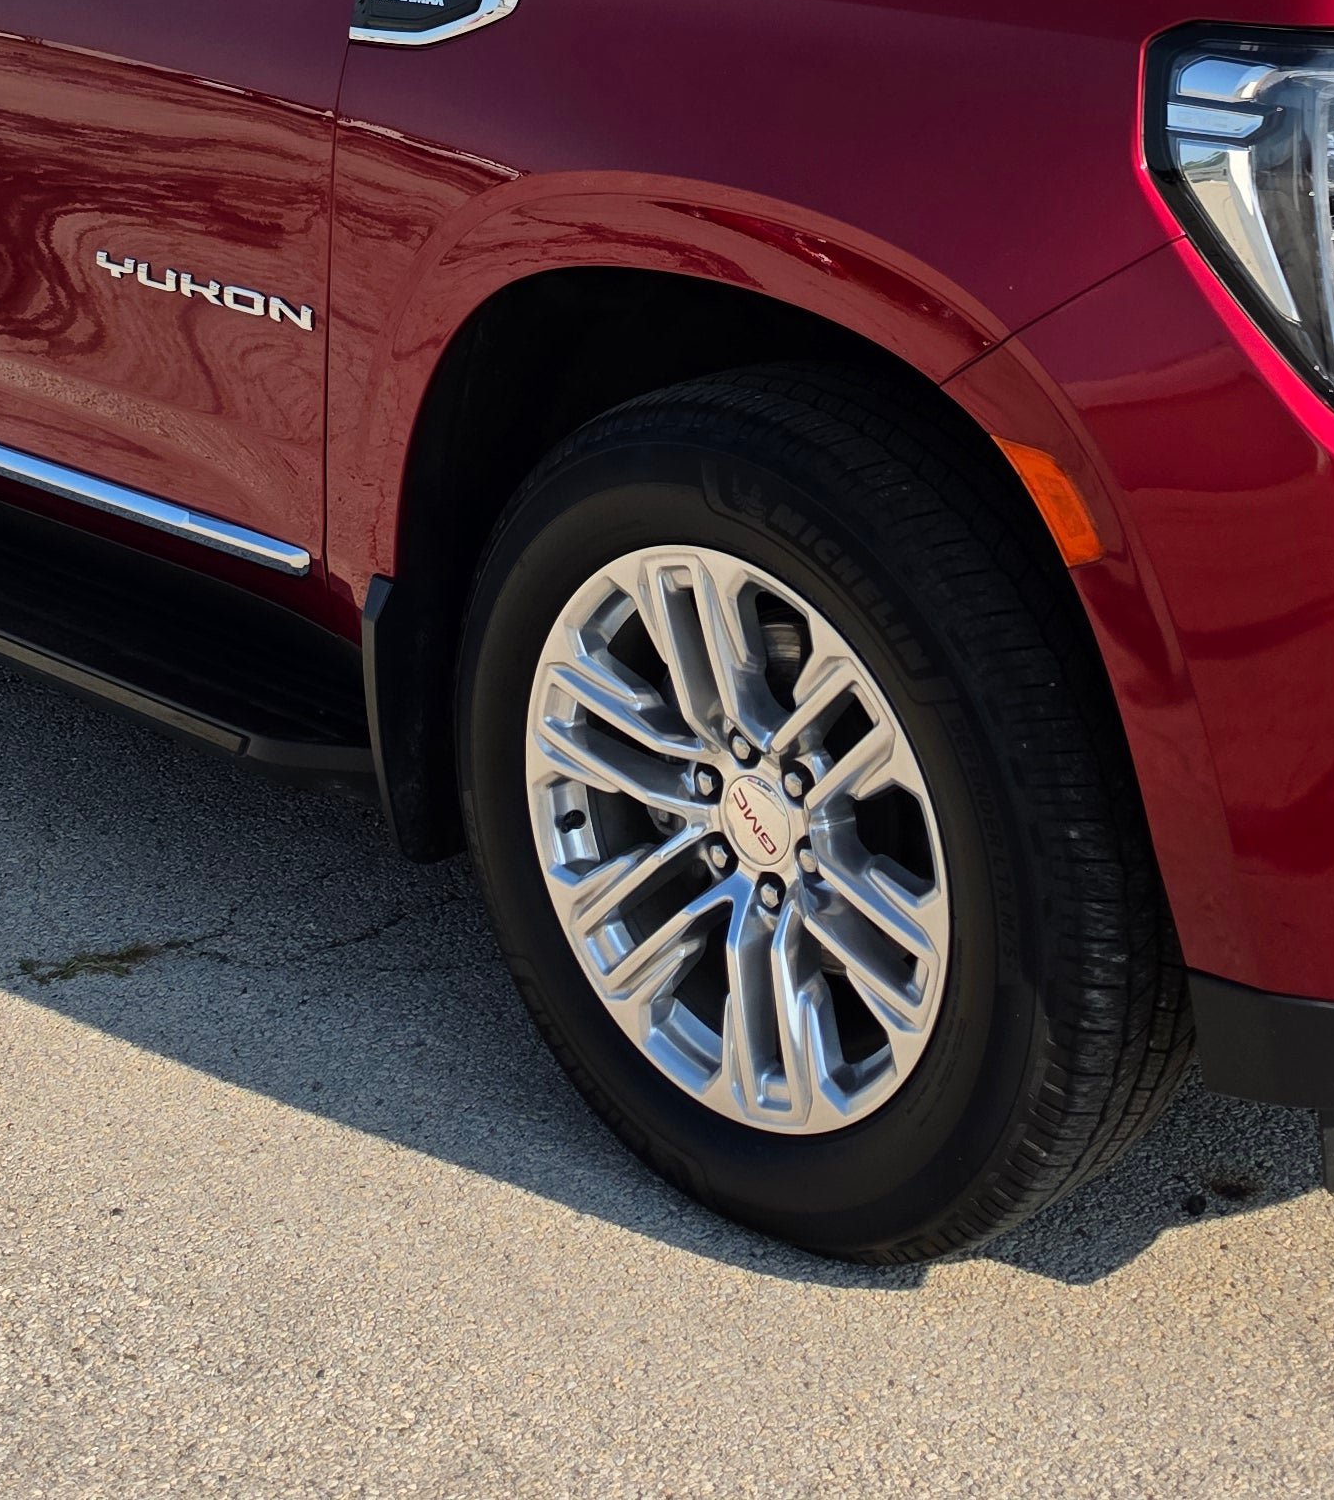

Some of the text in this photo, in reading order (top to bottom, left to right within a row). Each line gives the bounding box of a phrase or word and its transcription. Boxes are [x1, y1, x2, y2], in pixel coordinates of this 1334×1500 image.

[95, 250, 314, 332] YUKON
[769, 503, 934, 679] MICHELIN
[732, 787, 777, 856] GMC
[948, 716, 1004, 846] DEFENDER
